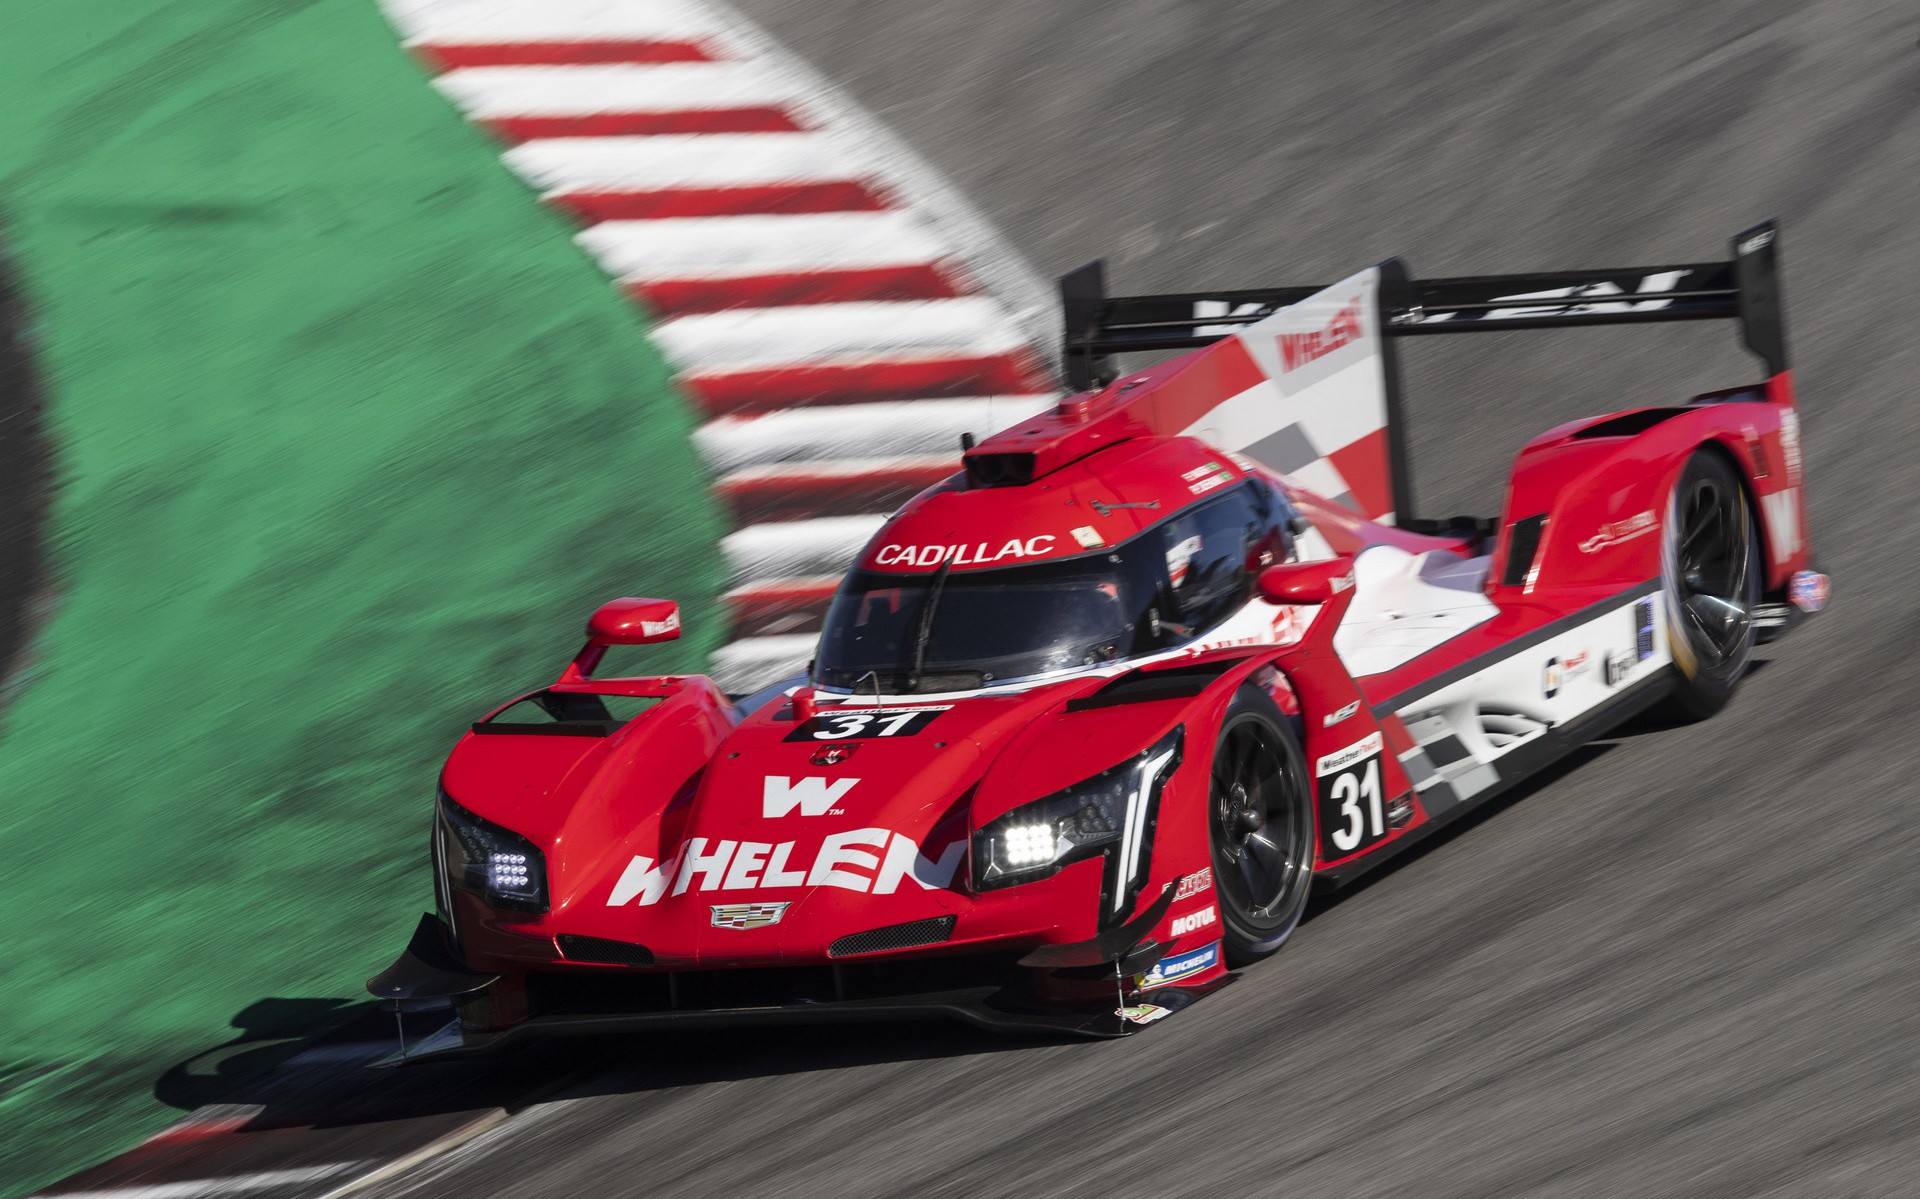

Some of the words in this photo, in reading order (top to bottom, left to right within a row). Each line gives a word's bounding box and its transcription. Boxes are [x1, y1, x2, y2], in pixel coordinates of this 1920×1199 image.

[875, 535, 1056, 567] CADILLAC
[813, 711, 920, 740] 31
[1330, 759, 1384, 850] 31
[606, 827, 969, 906] WHELEN
[1171, 906, 1217, 936] MOTUL
[1164, 950, 1214, 975] MICHELIN
